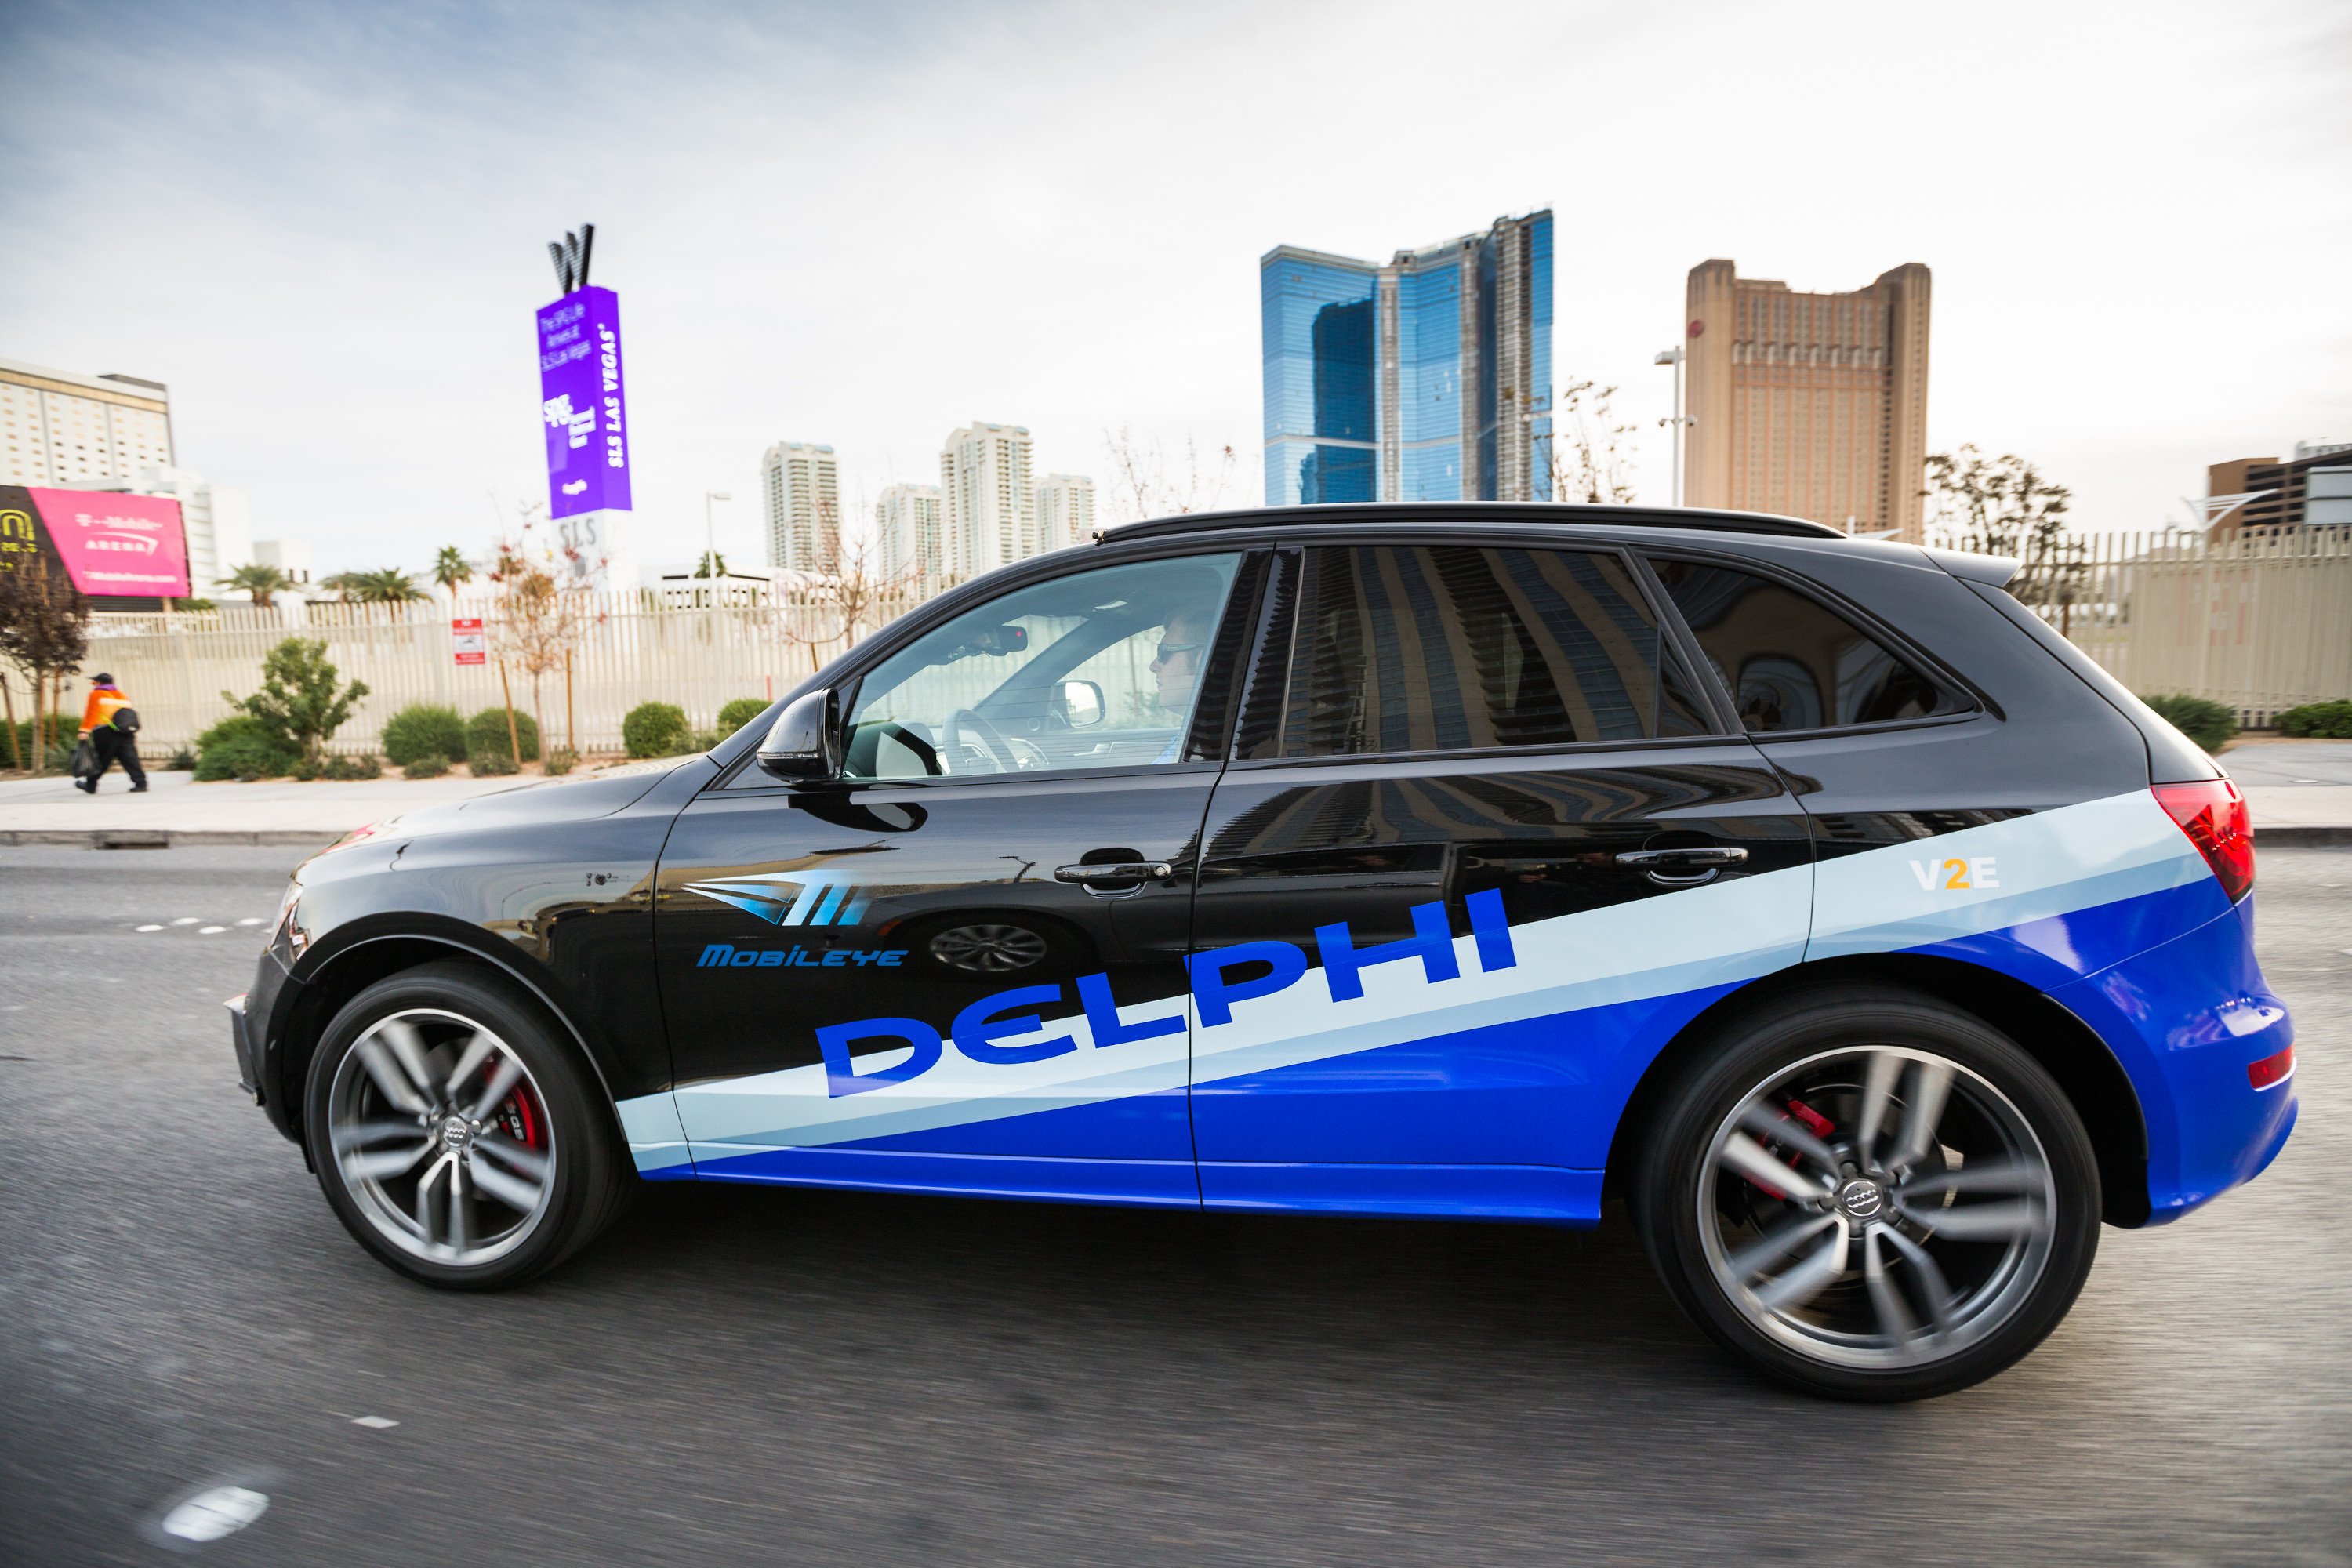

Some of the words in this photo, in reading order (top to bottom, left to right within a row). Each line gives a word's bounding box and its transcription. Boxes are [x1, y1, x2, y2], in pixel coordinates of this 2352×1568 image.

[599, 329, 619, 393] VEGAS
[604, 396, 622, 433] LAS
[607, 436, 624, 468] SLS
[85, 539, 147, 553] ARENA
[1908, 856, 2000, 891] V2E
[815, 887, 1518, 1098] DELPHI
